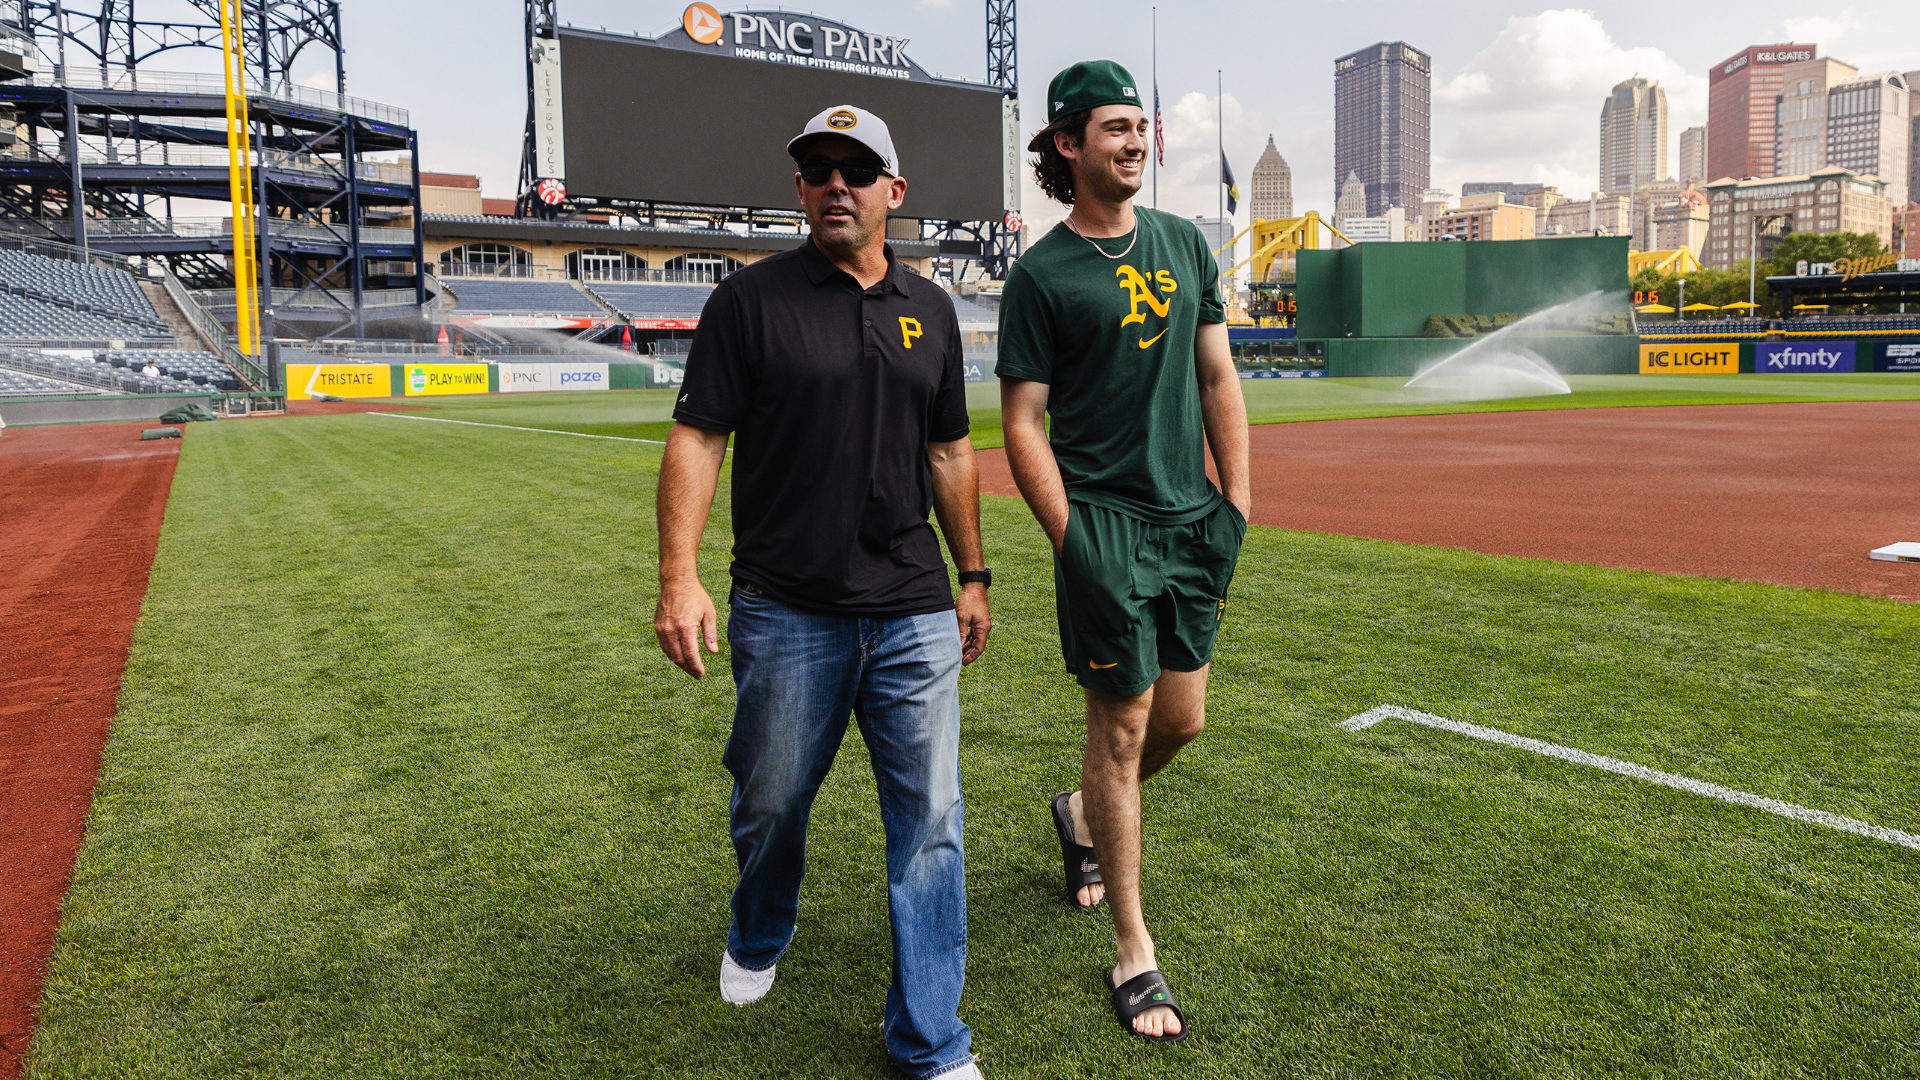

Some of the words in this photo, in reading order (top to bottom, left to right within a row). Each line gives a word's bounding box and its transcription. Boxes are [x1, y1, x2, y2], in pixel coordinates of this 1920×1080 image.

[730, 12, 813, 55] PNC
[820, 26, 911, 68] PARK
[1757, 52, 1776, 62] K&L
[1777, 51, 1811, 61] GATES
[735, 47, 767, 60] HOME
[768, 51, 785, 63] OF
[786, 54, 807, 66] THE
[808, 57, 869, 75] PITTSBURGH
[870, 66, 910, 80] PIRATES
[1832, 251, 1907, 282] Miller
[1634, 291, 1659, 303] 0:15
[1277, 300, 1297, 313] 0:15
[898, 316, 924, 349] P
[1886, 344, 1920, 356] ESP
[1648, 351, 1669, 367] IC
[1674, 352, 1730, 366] LIGHT
[1768, 347, 1842, 369] xfinity
[320, 373, 373, 385] TRISTATE
[430, 373, 452, 385] PLAY
[463, 372, 485, 385] WIN!
[512, 372, 543, 383] PNC
[560, 371, 602, 384] paze
